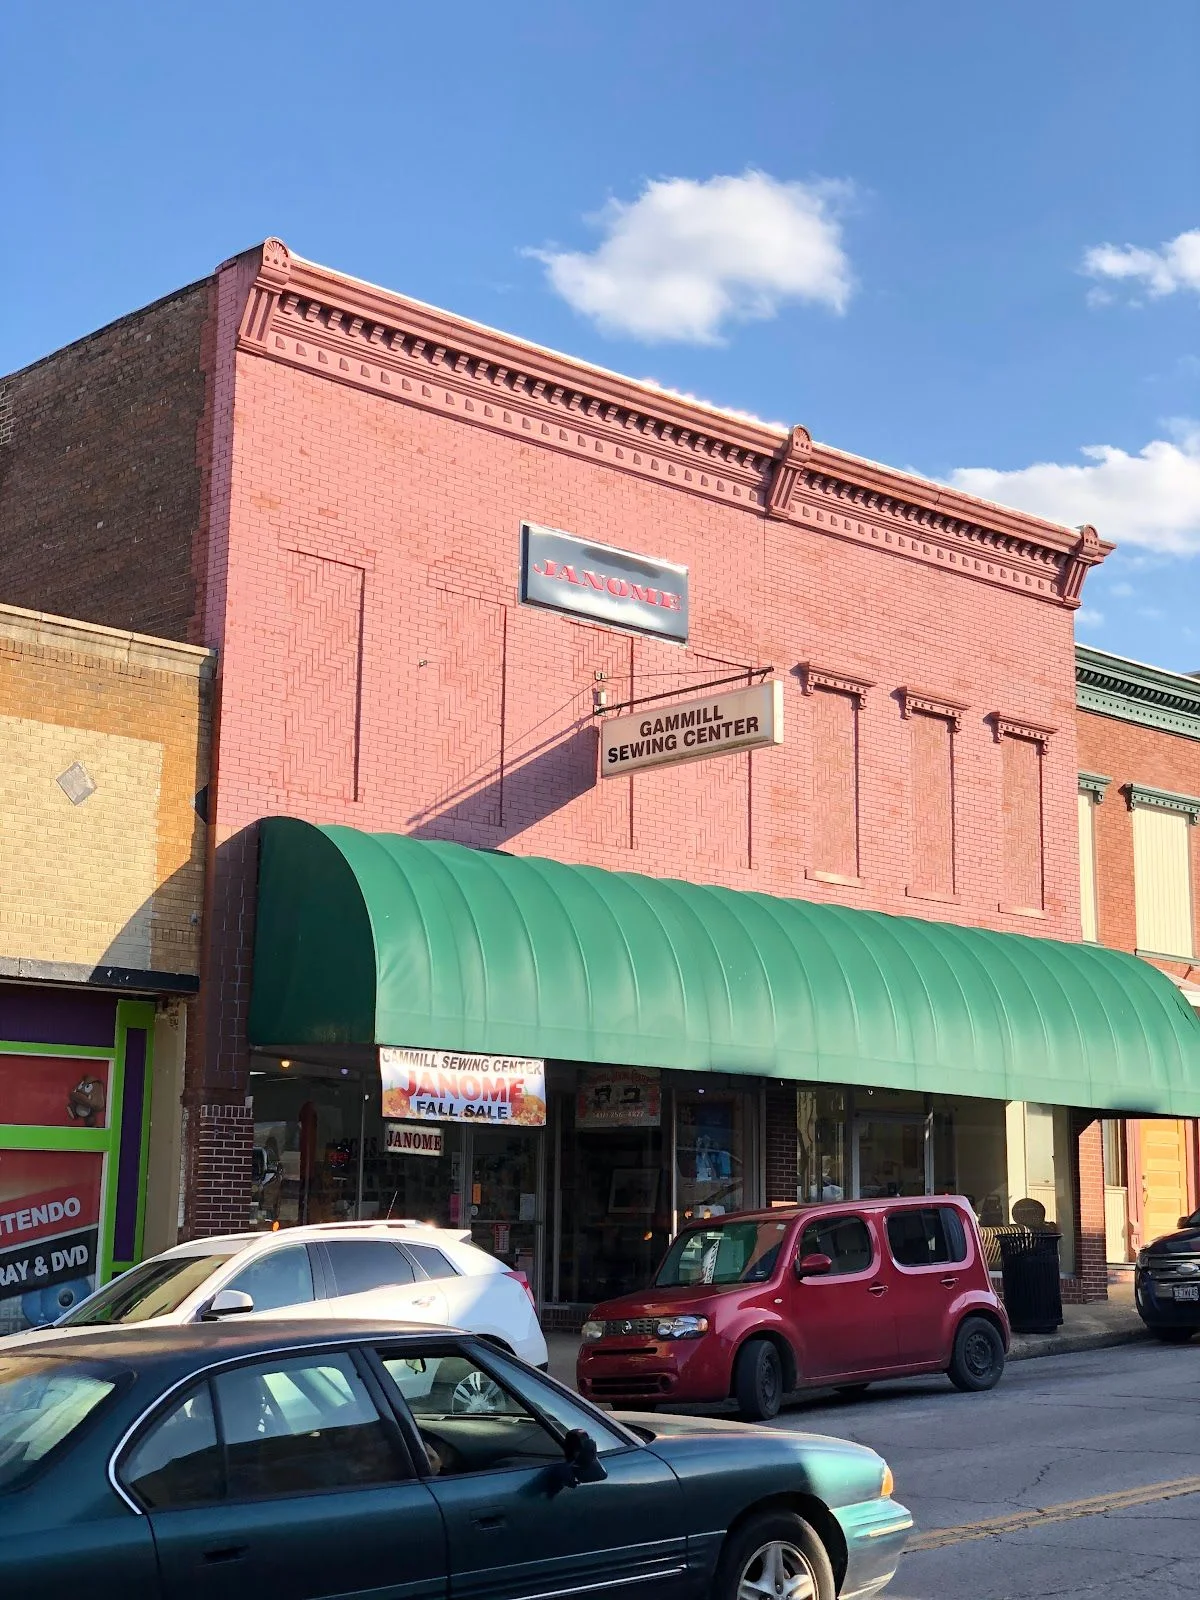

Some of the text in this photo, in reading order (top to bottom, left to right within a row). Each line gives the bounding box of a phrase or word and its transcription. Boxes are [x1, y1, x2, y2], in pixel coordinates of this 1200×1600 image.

[533, 559, 682, 612] JANOME
[639, 705, 724, 738] GAMMILL
[608, 716, 759, 764] SEWING CENTER
[382, 1049, 543, 1076] GAMMILL SEWING CENTER
[400, 1070, 526, 1104] JANOME
[416, 1100, 508, 1120] FALL SALE
[386, 1130, 442, 1151] JANOME
[0, 1197, 81, 1237] TENDO
[34, 1256, 49, 1277] &
[51, 1244, 89, 1272] DVD
